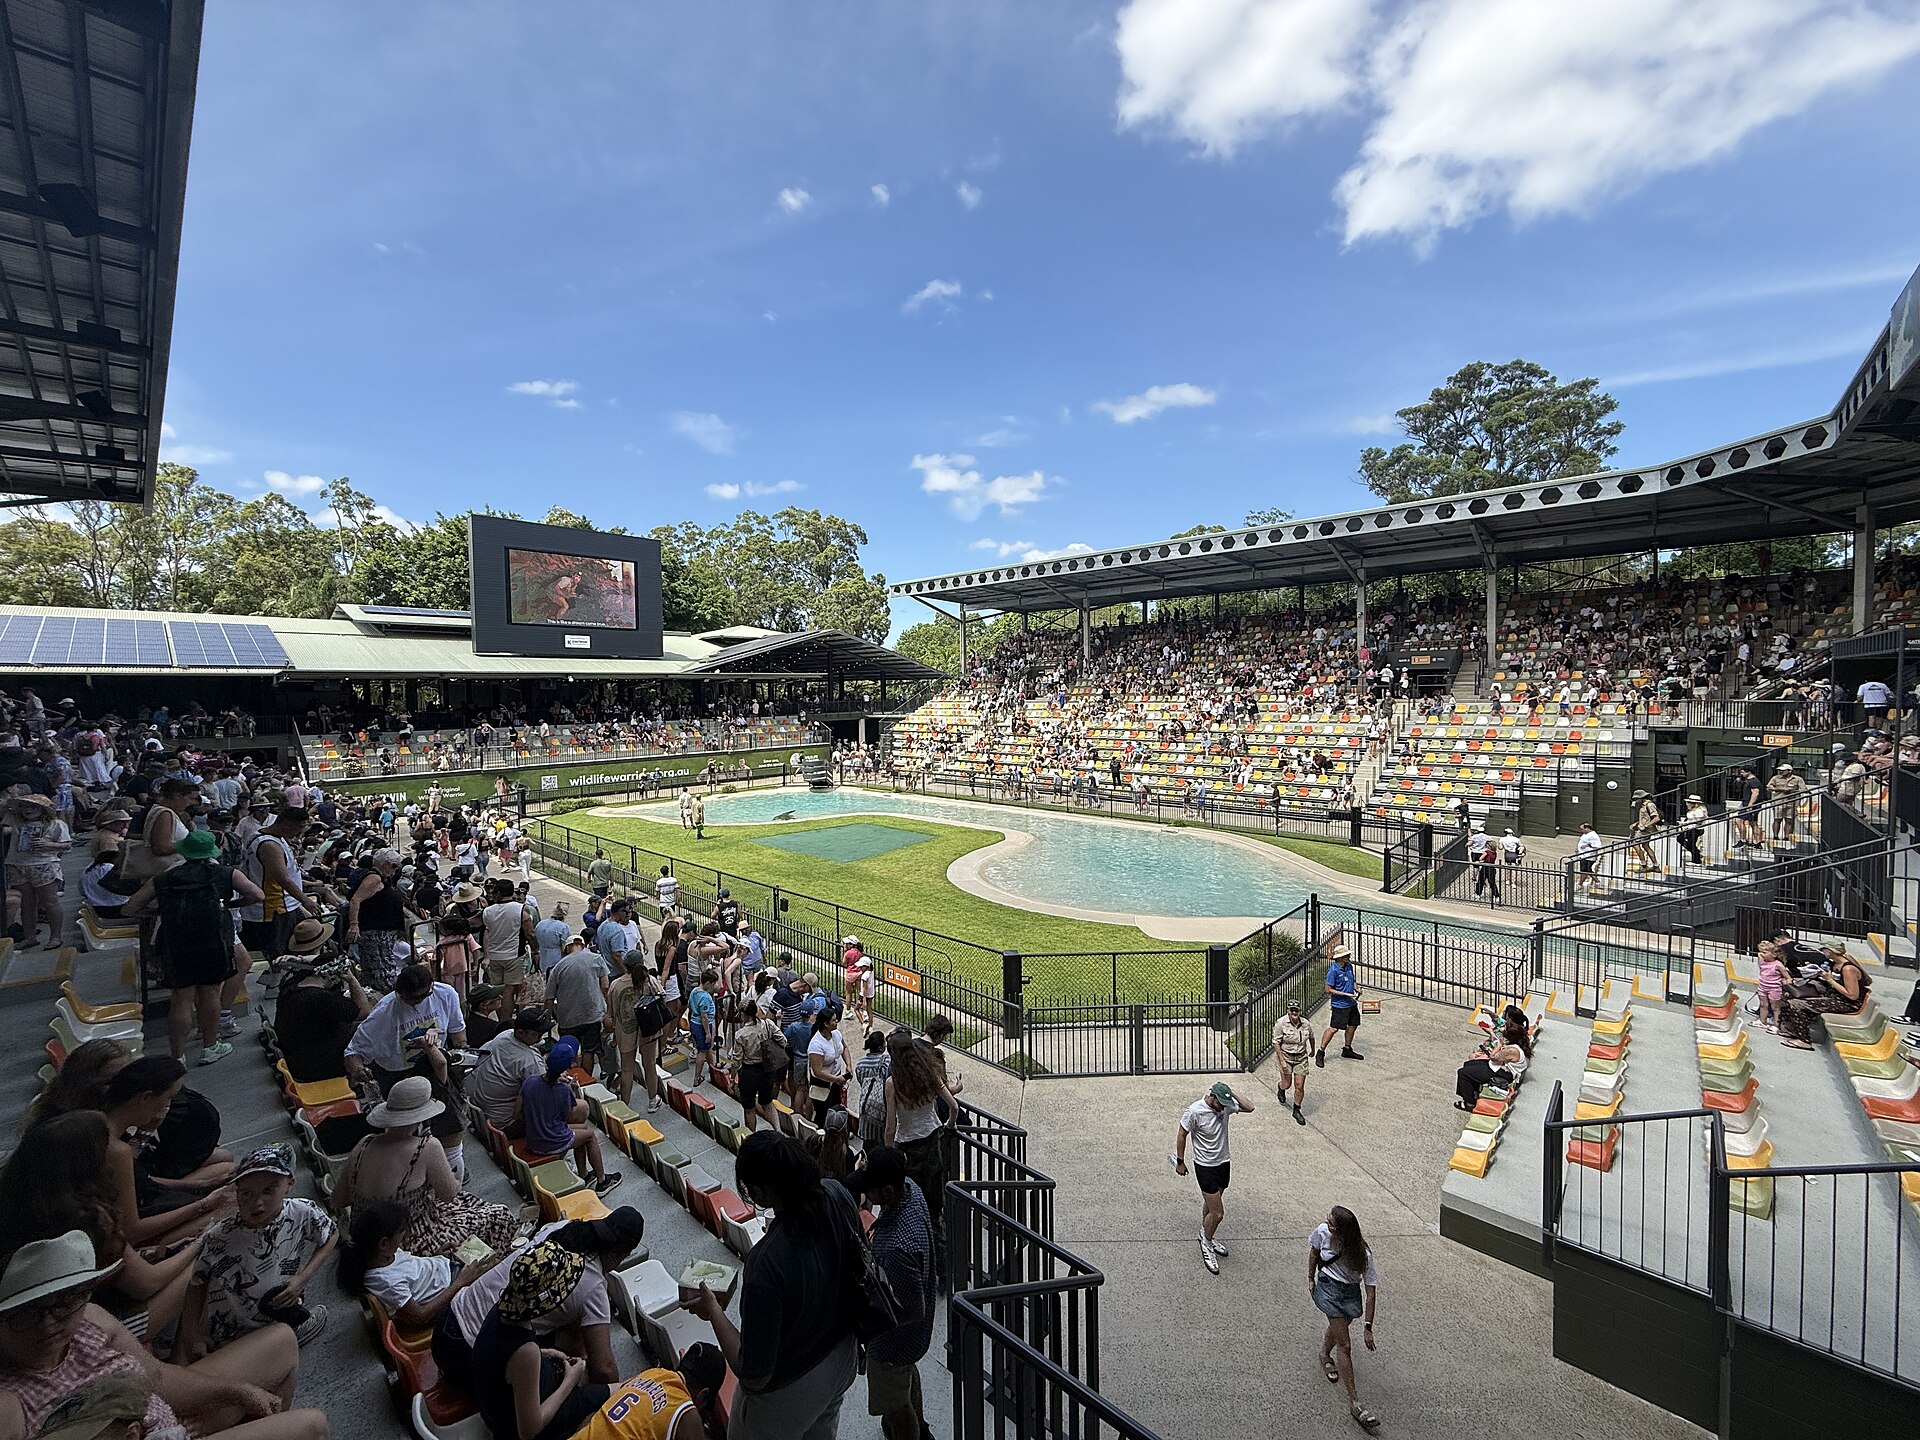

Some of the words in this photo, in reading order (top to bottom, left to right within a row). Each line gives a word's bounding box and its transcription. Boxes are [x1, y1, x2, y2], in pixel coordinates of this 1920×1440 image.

[569, 768, 690, 786] wildlifewarrisorg.au
[896, 972, 910, 984] EXIT
[607, 1392, 640, 1423] 6
